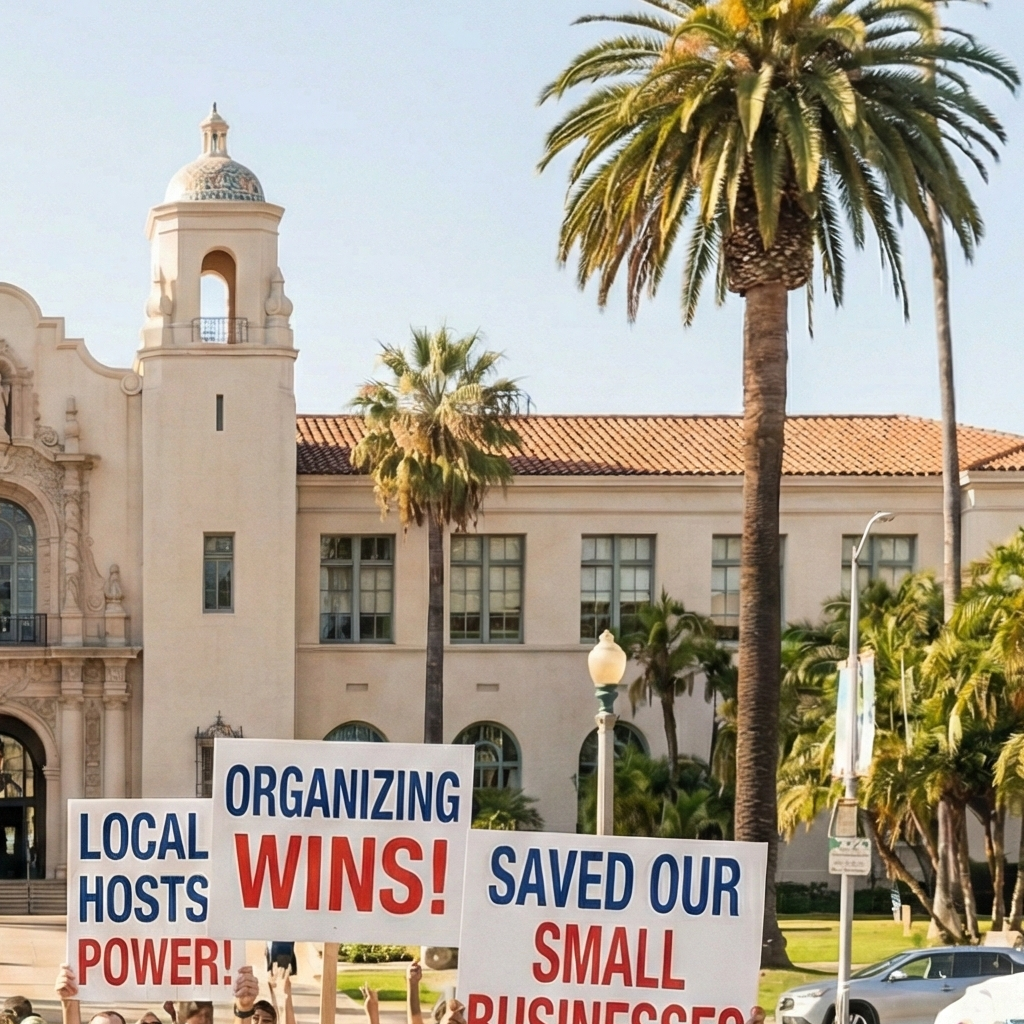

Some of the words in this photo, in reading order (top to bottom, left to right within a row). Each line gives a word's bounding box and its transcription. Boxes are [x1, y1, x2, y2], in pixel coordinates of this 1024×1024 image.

[226, 764, 460, 823] ORGANIZING
[80, 812, 209, 861] LOCAL
[79, 874, 209, 923] HOSTS
[234, 833, 448, 915] WINS!
[488, 845, 634, 911] SAVED
[649, 853, 741, 917] OUR
[78, 937, 232, 987] POWER!
[532, 921, 685, 990] SMALL
